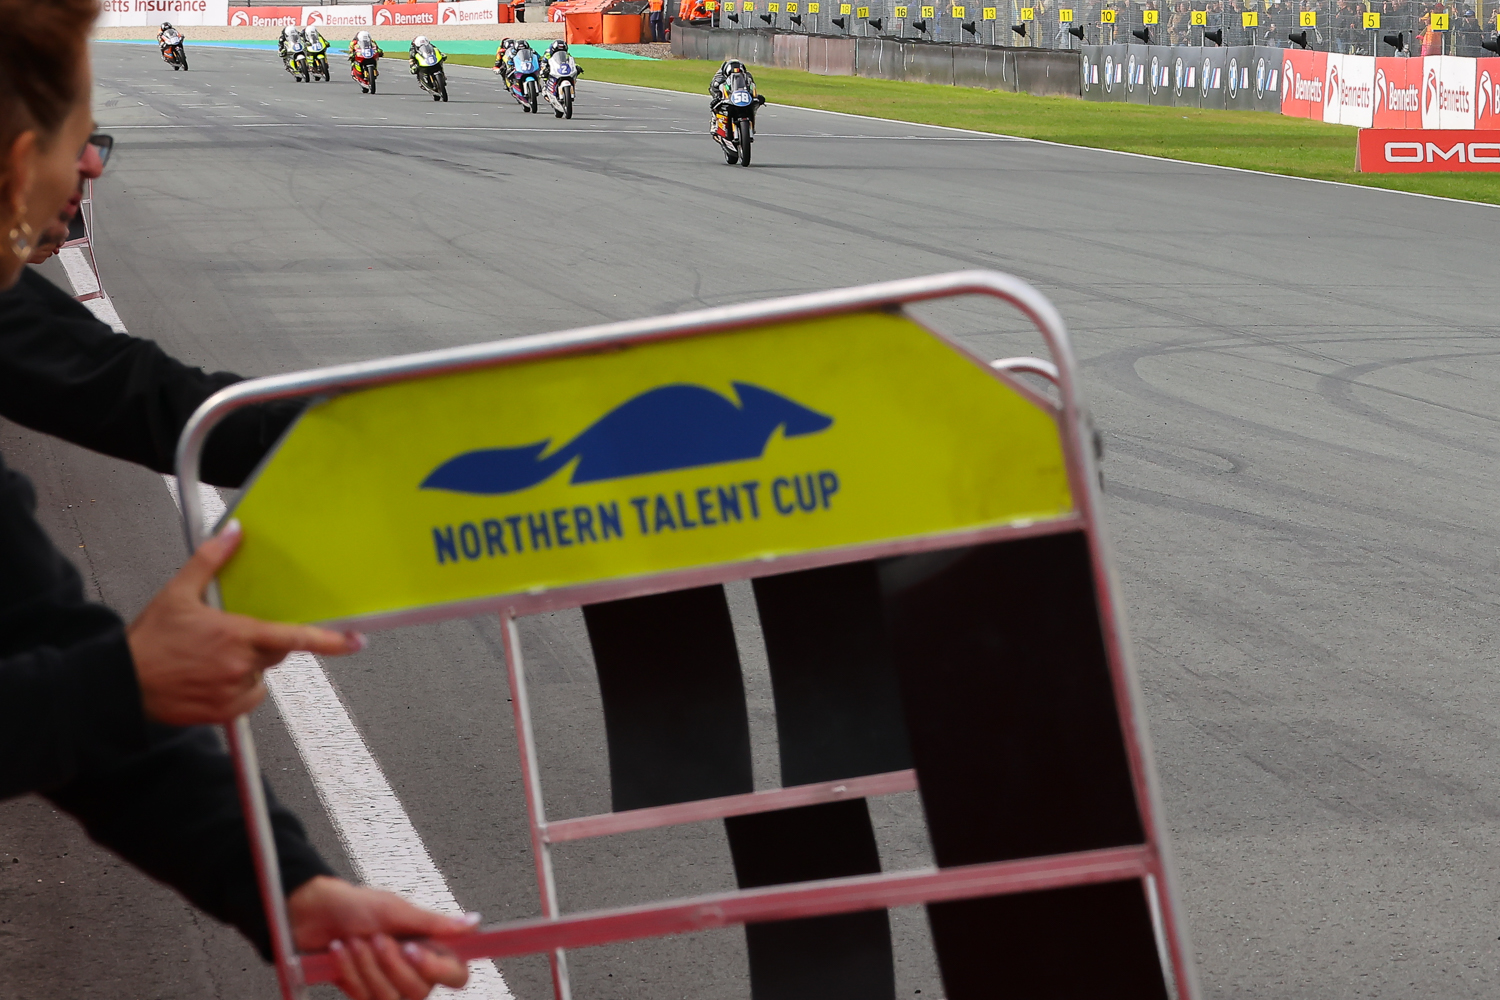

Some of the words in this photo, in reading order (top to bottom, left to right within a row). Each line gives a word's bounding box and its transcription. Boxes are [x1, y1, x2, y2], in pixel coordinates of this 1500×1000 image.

[726, 2, 734, 10] 23
[745, 2, 753, 10] 22
[770, 4, 778, 12] 21
[788, 3, 796, 11] 20
[810, 4, 818, 12] 19
[842, 5, 849, 13] 18
[460, 10, 493, 21] Bennetts
[859, 8, 867, 16] 17
[897, 8, 906, 17] 16
[924, 7, 932, 17] 15
[954, 8, 963, 17] 14
[985, 9, 994, 19] 13
[1023, 10, 1032, 19] 12
[1062, 11, 1070, 20] 11
[1102, 11, 1112, 21] 10
[1147, 12, 1153, 23] 9
[252, 15, 296, 26] Bennetts
[326, 14, 367, 25] Bennetts
[394, 12, 434, 25] Bennetts
[1196, 13, 1202, 24] 8
[1248, 14, 1253, 25] 7
[1304, 13, 1311, 25] 6
[1368, 15, 1375, 27] 5
[1436, 16, 1443, 28] 4
[562, 65, 568, 73] 2
[1295, 72, 1323, 102] Bennetts
[732, 92, 749, 103] 58
[1341, 79, 1370, 108] Bennetts
[1389, 81, 1419, 111] Bennetts
[1439, 81, 1469, 113] Bennetts
[431, 499, 624, 565] NORTHERN
[630, 479, 761, 536] TALENT
[771, 471, 840, 516] CUP
